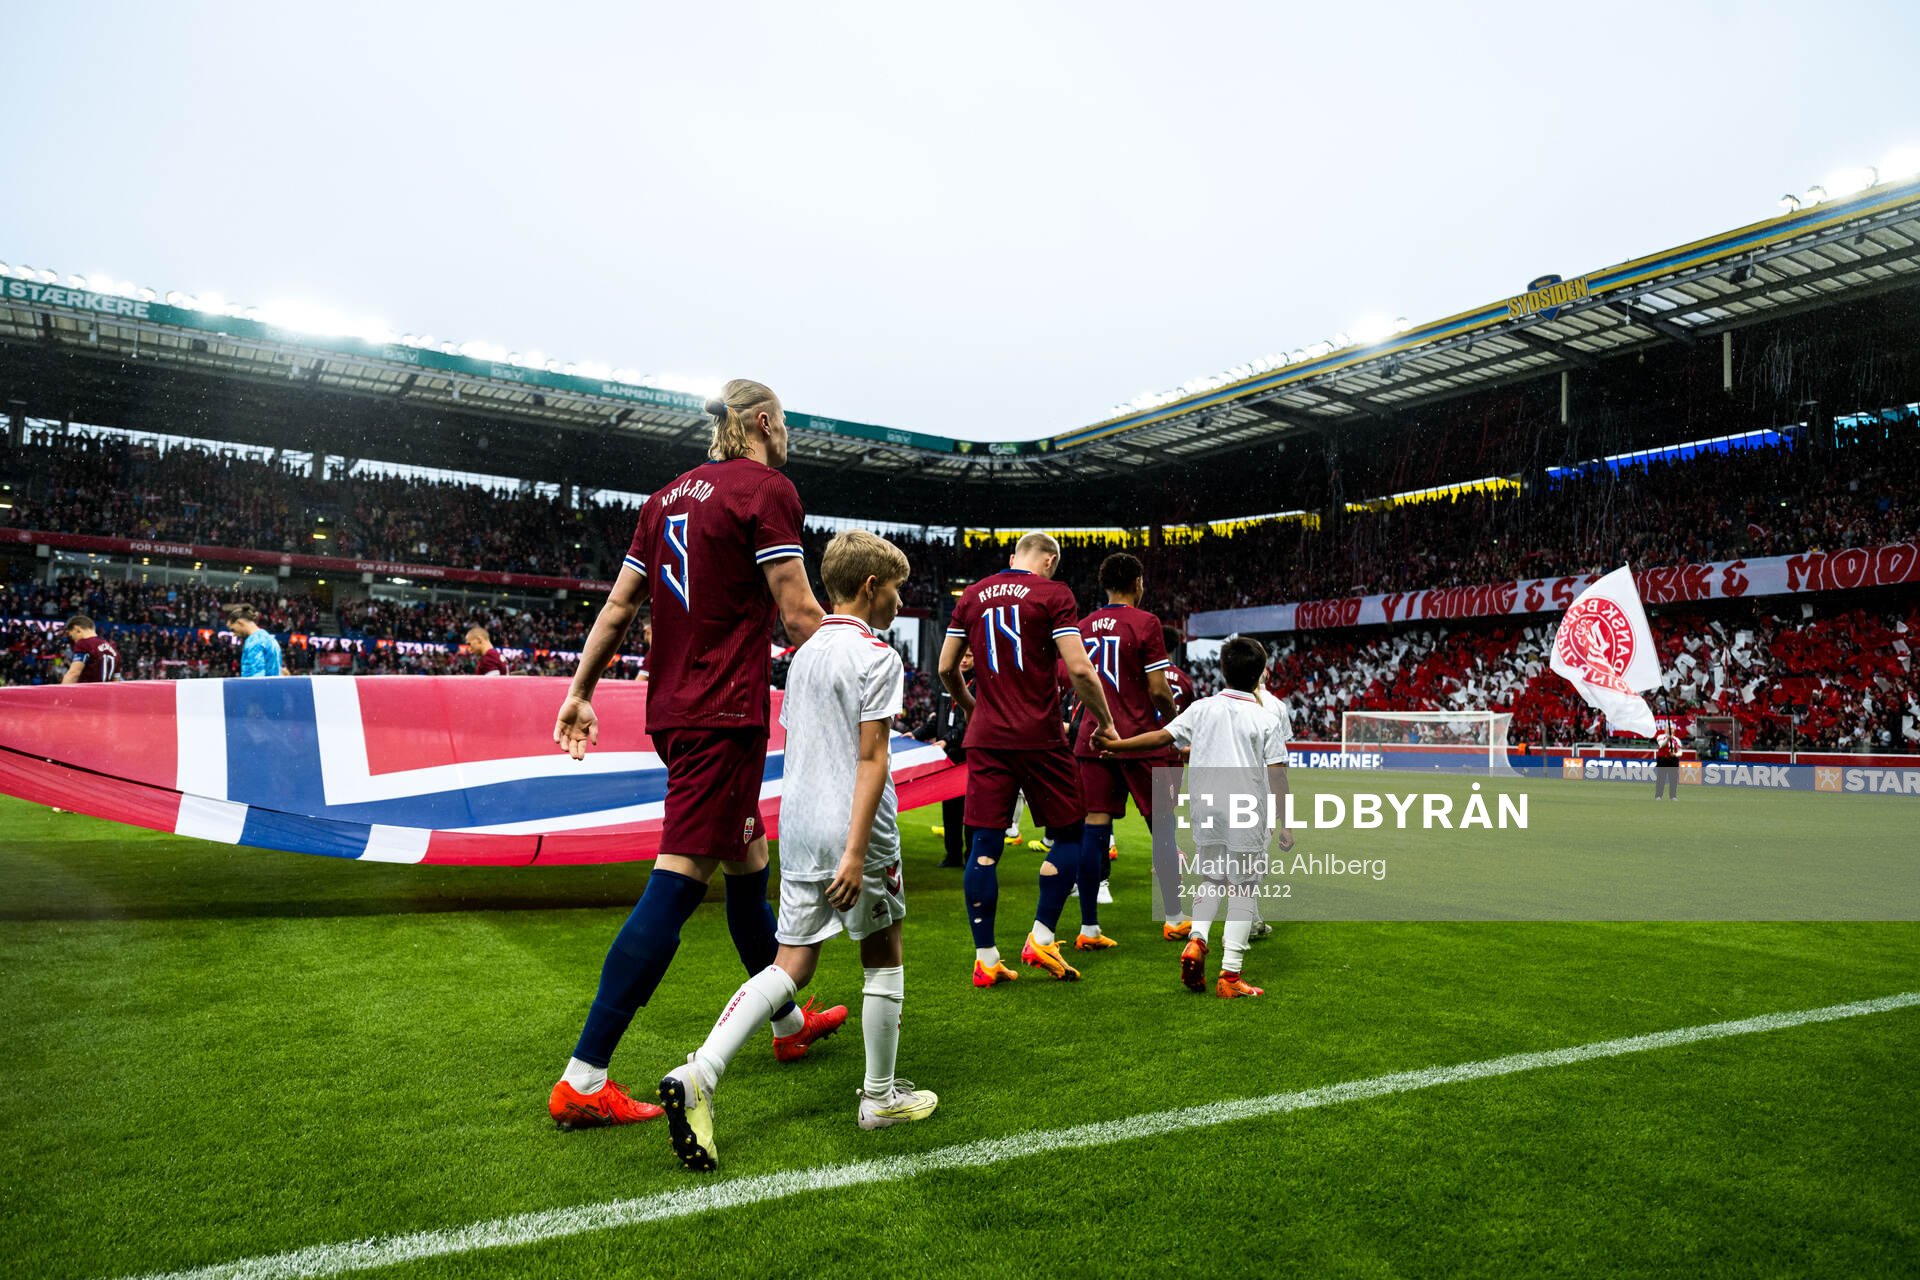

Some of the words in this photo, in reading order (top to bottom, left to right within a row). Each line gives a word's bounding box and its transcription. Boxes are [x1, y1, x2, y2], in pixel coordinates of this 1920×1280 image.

[9, 281, 150, 318] STÆRKERE
[1508, 277, 1588, 318] SYDSIDEN
[602, 384, 654, 401] SAMMEN
[130, 542, 152, 552] FOR
[154, 545, 193, 555] SEJREN
[661, 512, 690, 613] 9
[1786, 543, 1918, 592] MOD
[978, 583, 1031, 604] RYERSON
[1091, 617, 1117, 633] NUSA
[981, 604, 1024, 675] 14
[1288, 752, 1308, 768] EL
[1309, 752, 1384, 770] PARTNER
[1585, 759, 1657, 782] STARK
[1704, 763, 1791, 788] STARK
[1845, 768, 1920, 794] STAR
